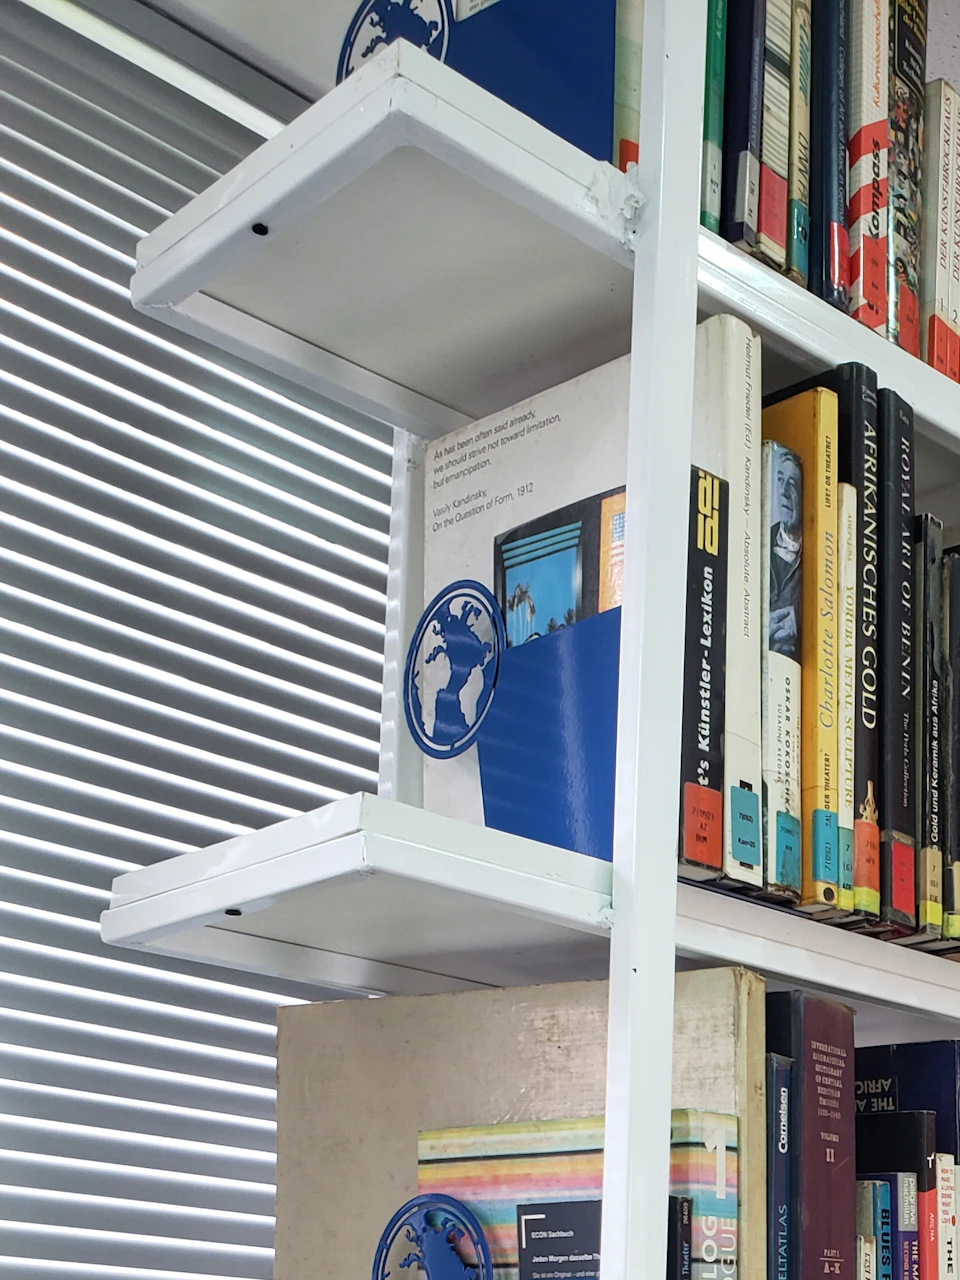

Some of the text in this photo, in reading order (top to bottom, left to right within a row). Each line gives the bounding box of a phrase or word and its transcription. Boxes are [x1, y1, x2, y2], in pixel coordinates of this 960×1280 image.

[941, 94, 951, 233] KUNST-BROCKHAUS
[940, 236, 948, 271] DER
[952, 249, 960, 283] DER
[433, 449, 443, 460] As
[443, 444, 456, 456] has
[457, 437, 474, 451] been
[474, 429, 493, 443] often
[493, 420, 509, 434] said
[433, 464, 444, 475] we
[444, 453, 467, 471] should
[467, 446, 487, 461] strive
[487, 439, 500, 451] not
[500, 429, 526, 446] toward
[862, 420, 877, 640] AFRIKANISCHES
[900, 436, 911, 701] ROYAL ART OF BENIN
[819, 531, 834, 728] Charlotte Salomon
[862, 645, 877, 730] GOLD
[930, 680, 939, 842] Gold und Keramik aus Afrika
[778, 1087, 788, 1154] Cornelsen
[704, 1126, 726, 1199] 1
[531, 1230, 574, 1239] ECON Sachbuch
[531, 1253, 592, 1264] Jeden Morgen dasselbe
[881, 1208, 892, 1267] BLUES
